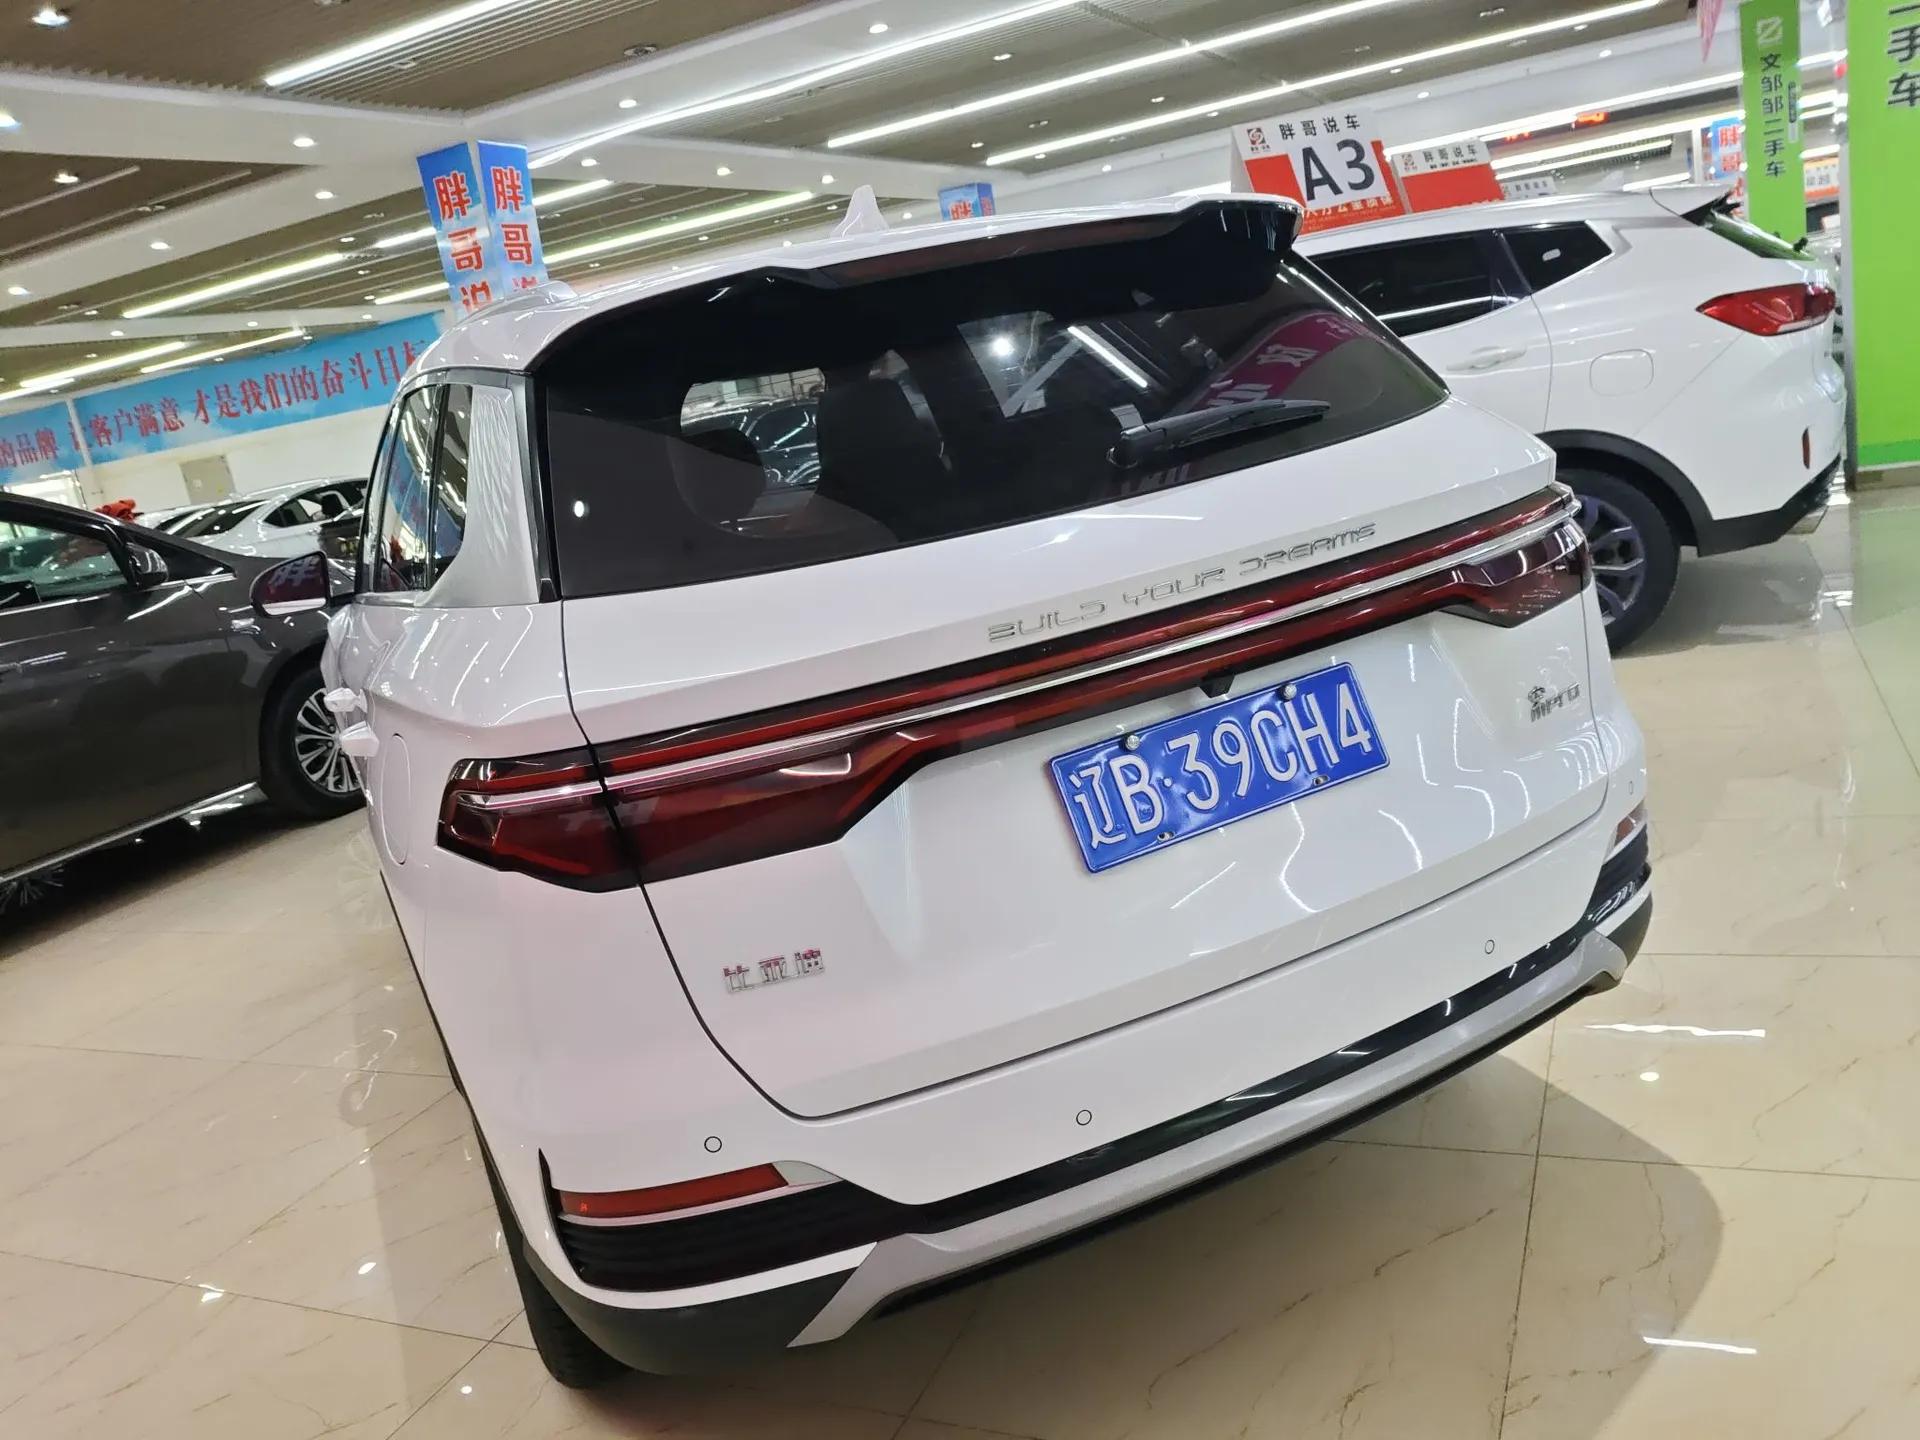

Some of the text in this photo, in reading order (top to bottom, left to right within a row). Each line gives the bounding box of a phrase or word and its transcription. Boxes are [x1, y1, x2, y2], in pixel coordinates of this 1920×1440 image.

[1888, 4, 1920, 107] 手车
[1278, 114, 1361, 141] 胖哥说车
[1761, 52, 1786, 178] 文邹邹二手车
[1301, 138, 1375, 202] A3
[987, 522, 1376, 643] BUILD YOUR DREAMS
[1069, 683, 1372, 849] 辽B·39CH4
[723, 949, 825, 994] 比亚迪
